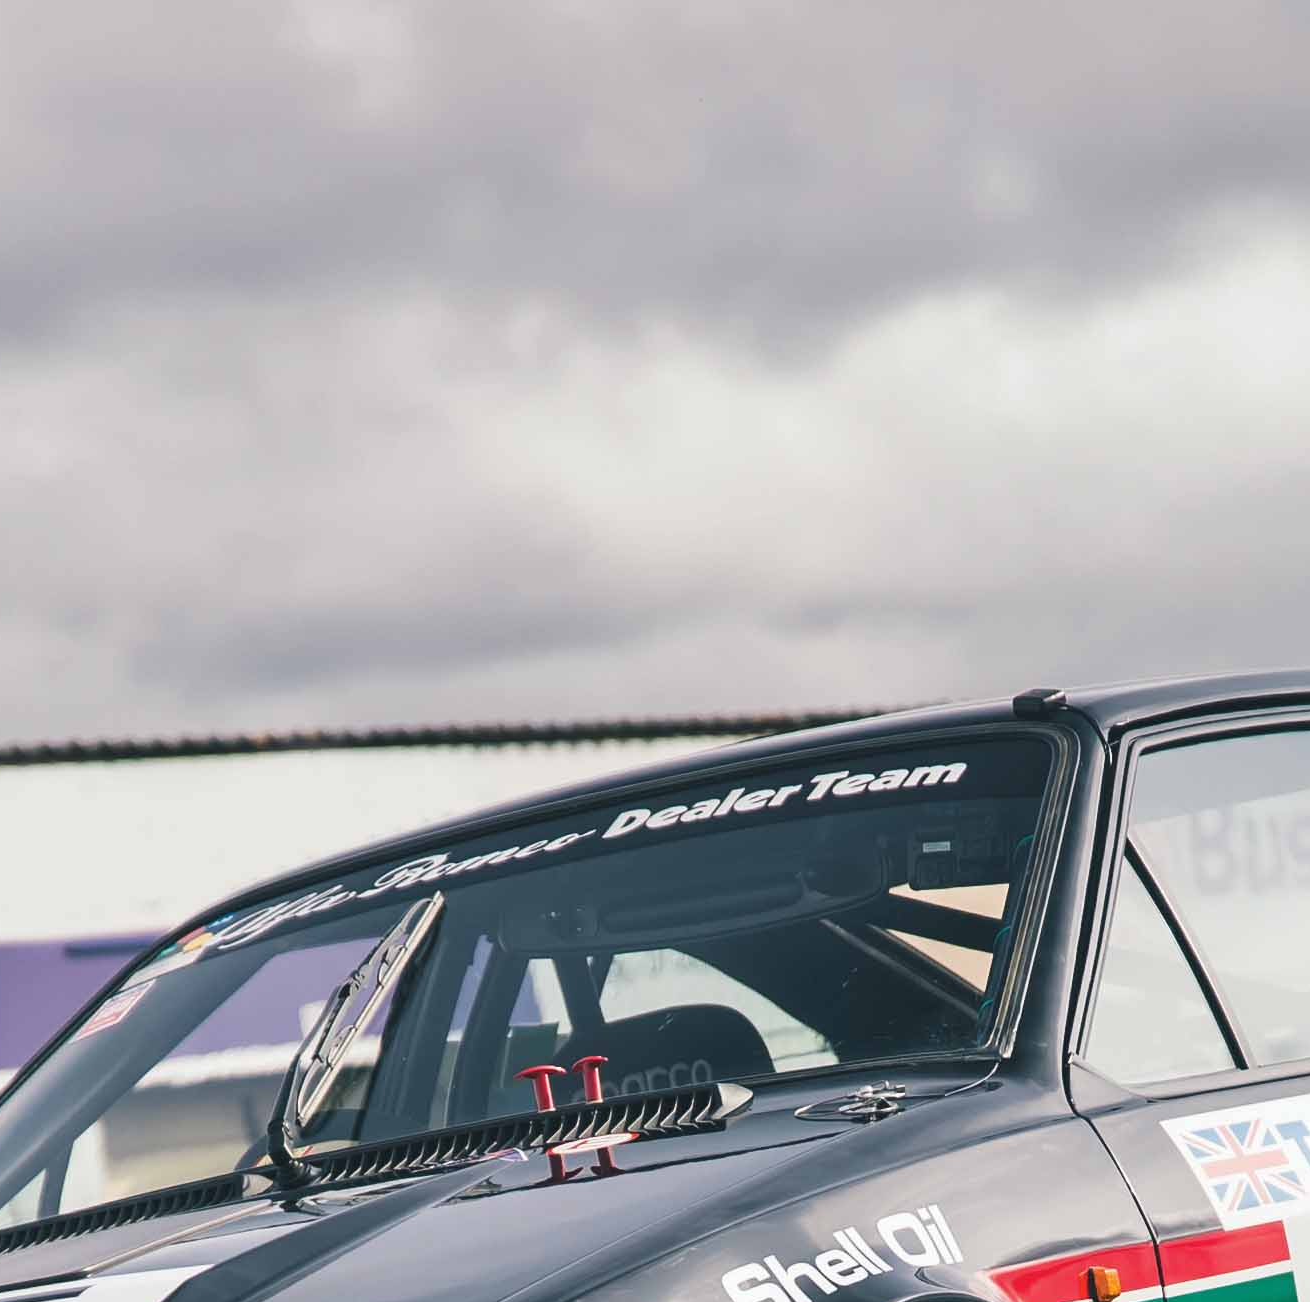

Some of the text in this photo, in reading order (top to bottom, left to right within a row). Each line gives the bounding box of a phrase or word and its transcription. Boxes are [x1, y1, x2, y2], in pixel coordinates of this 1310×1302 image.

[210, 761, 968, 950] Alfa Romeo Dealer Team
[876, 1204, 964, 1268] Oil
